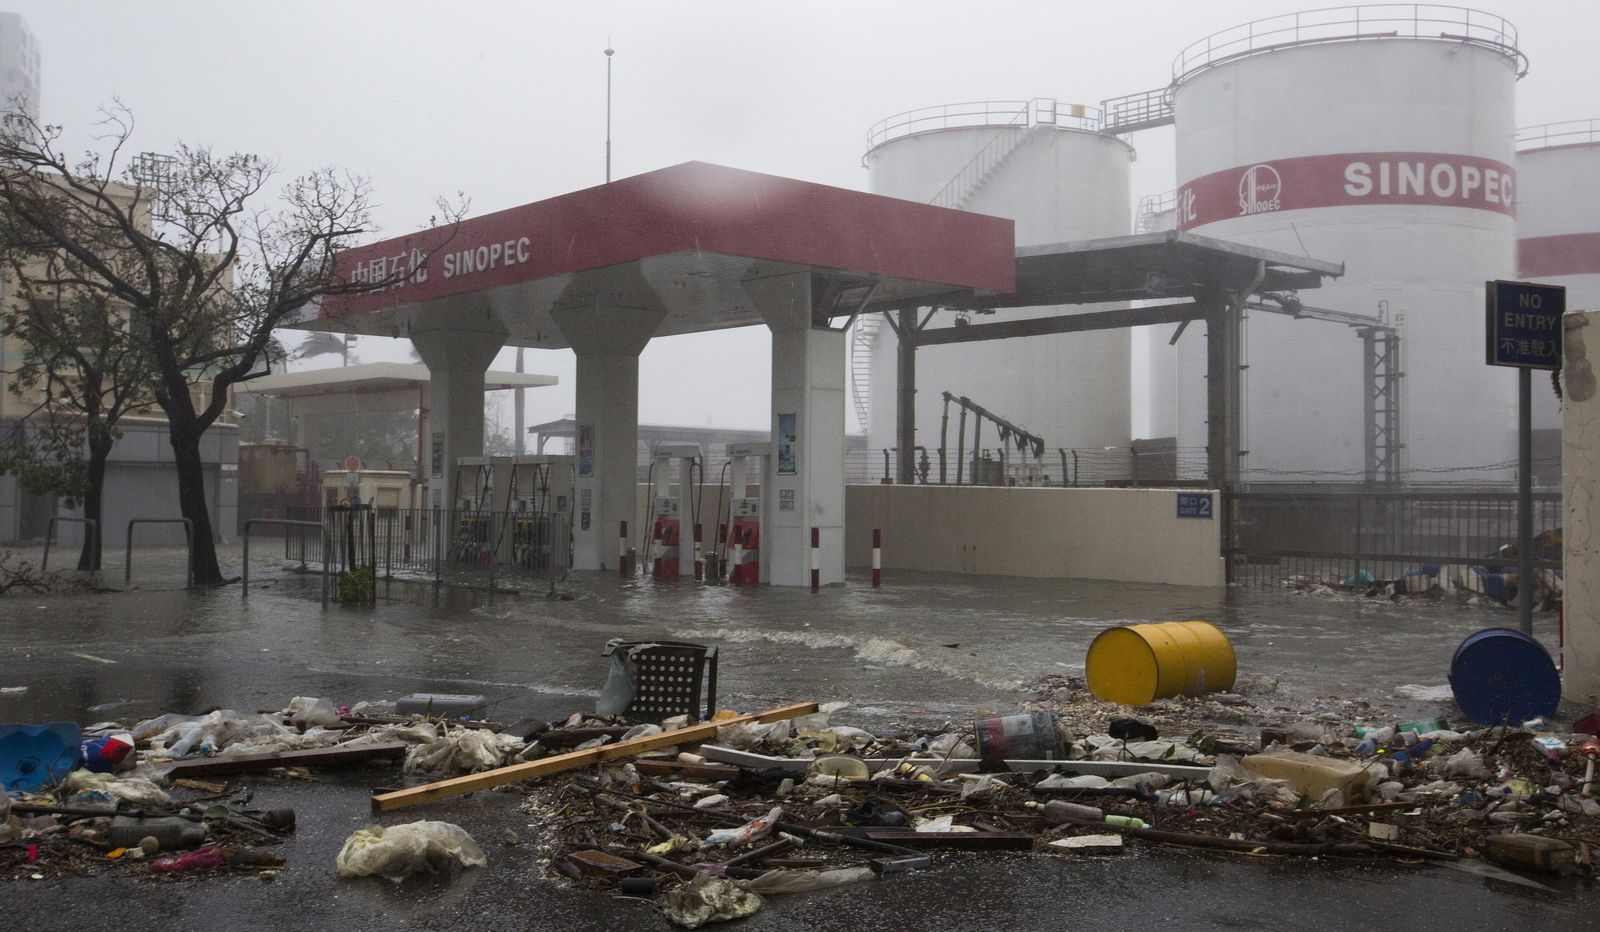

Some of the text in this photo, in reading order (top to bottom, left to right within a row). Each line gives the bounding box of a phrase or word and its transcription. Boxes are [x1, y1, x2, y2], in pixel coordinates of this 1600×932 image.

[1344, 161, 1513, 207] SINOPEC
[443, 236, 530, 278] SINOPEC
[1519, 293, 1542, 309] NO
[1504, 312, 1557, 331] ENTRY
[1199, 498, 1210, 515] 2
